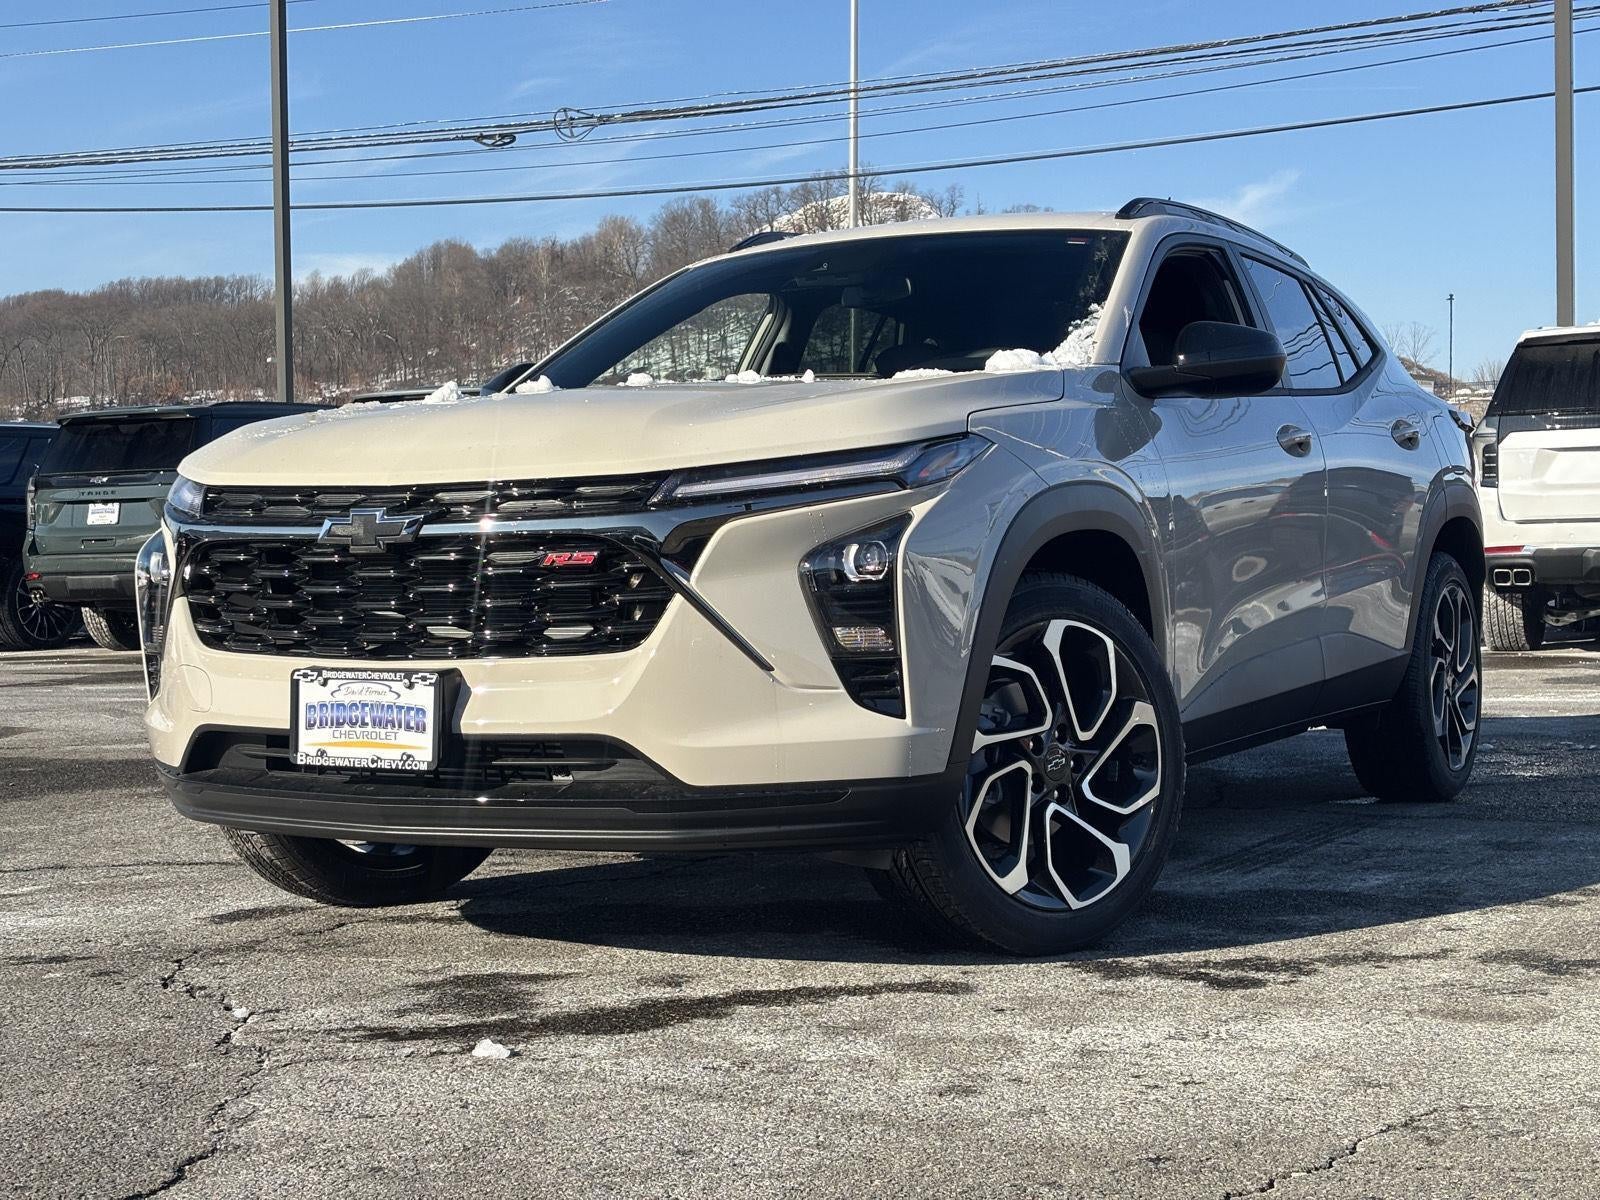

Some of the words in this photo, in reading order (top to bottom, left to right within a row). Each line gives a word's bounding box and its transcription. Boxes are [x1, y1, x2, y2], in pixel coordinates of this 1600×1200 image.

[541, 551, 598, 567] RS
[305, 701, 428, 734] BRIDGEWATER
[332, 729, 400, 741] CHEVROLET
